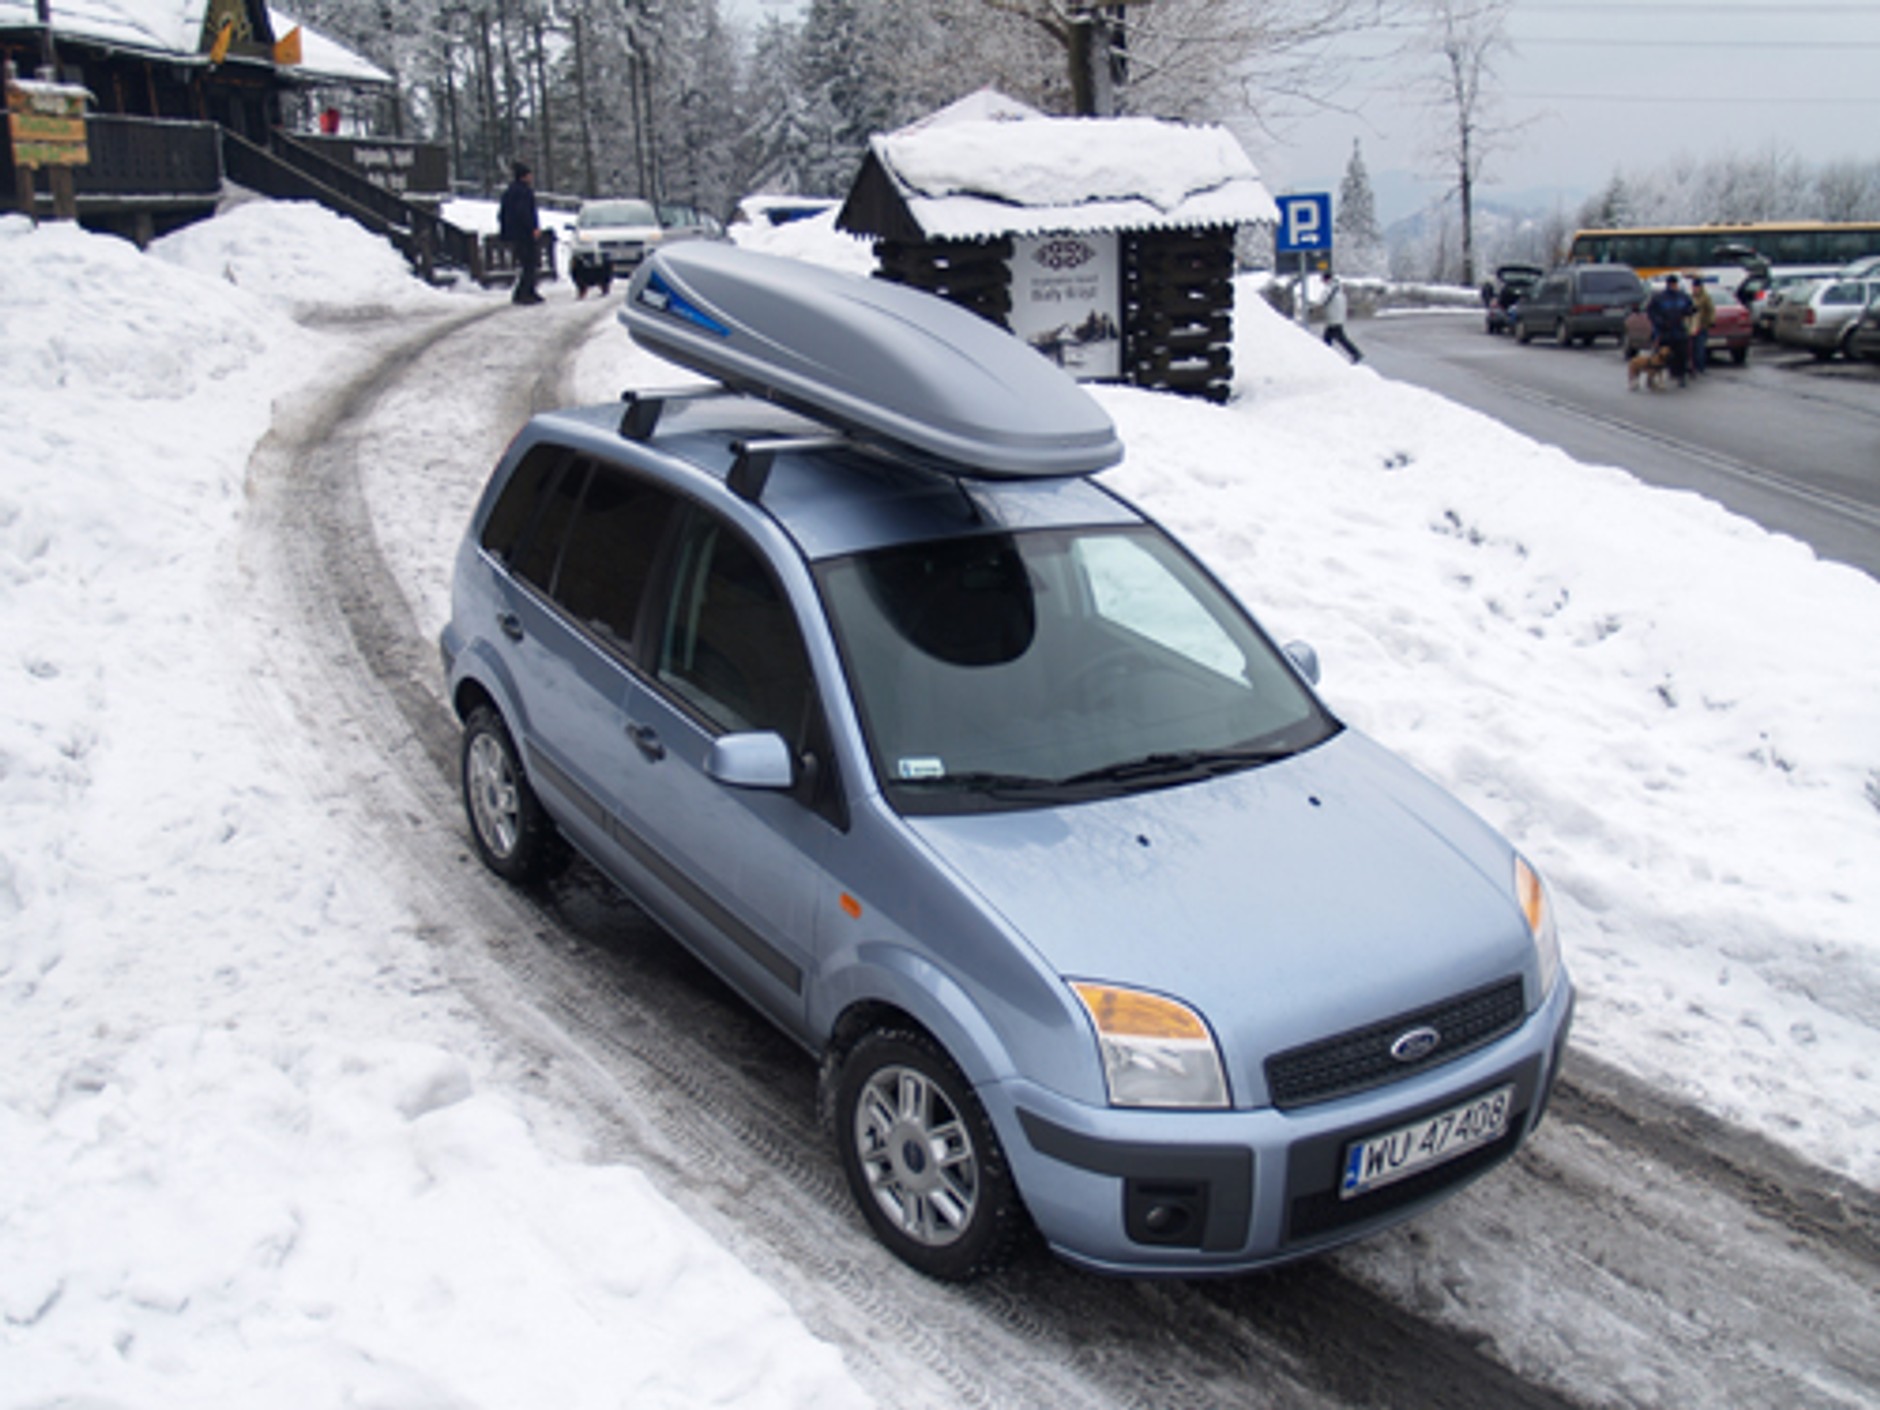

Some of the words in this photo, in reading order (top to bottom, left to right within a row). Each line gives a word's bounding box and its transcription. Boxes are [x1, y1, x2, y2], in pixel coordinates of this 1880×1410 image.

[1288, 200, 1321, 245] P
[1366, 1131, 1412, 1177] WU
[1419, 1094, 1506, 1154] 47408
